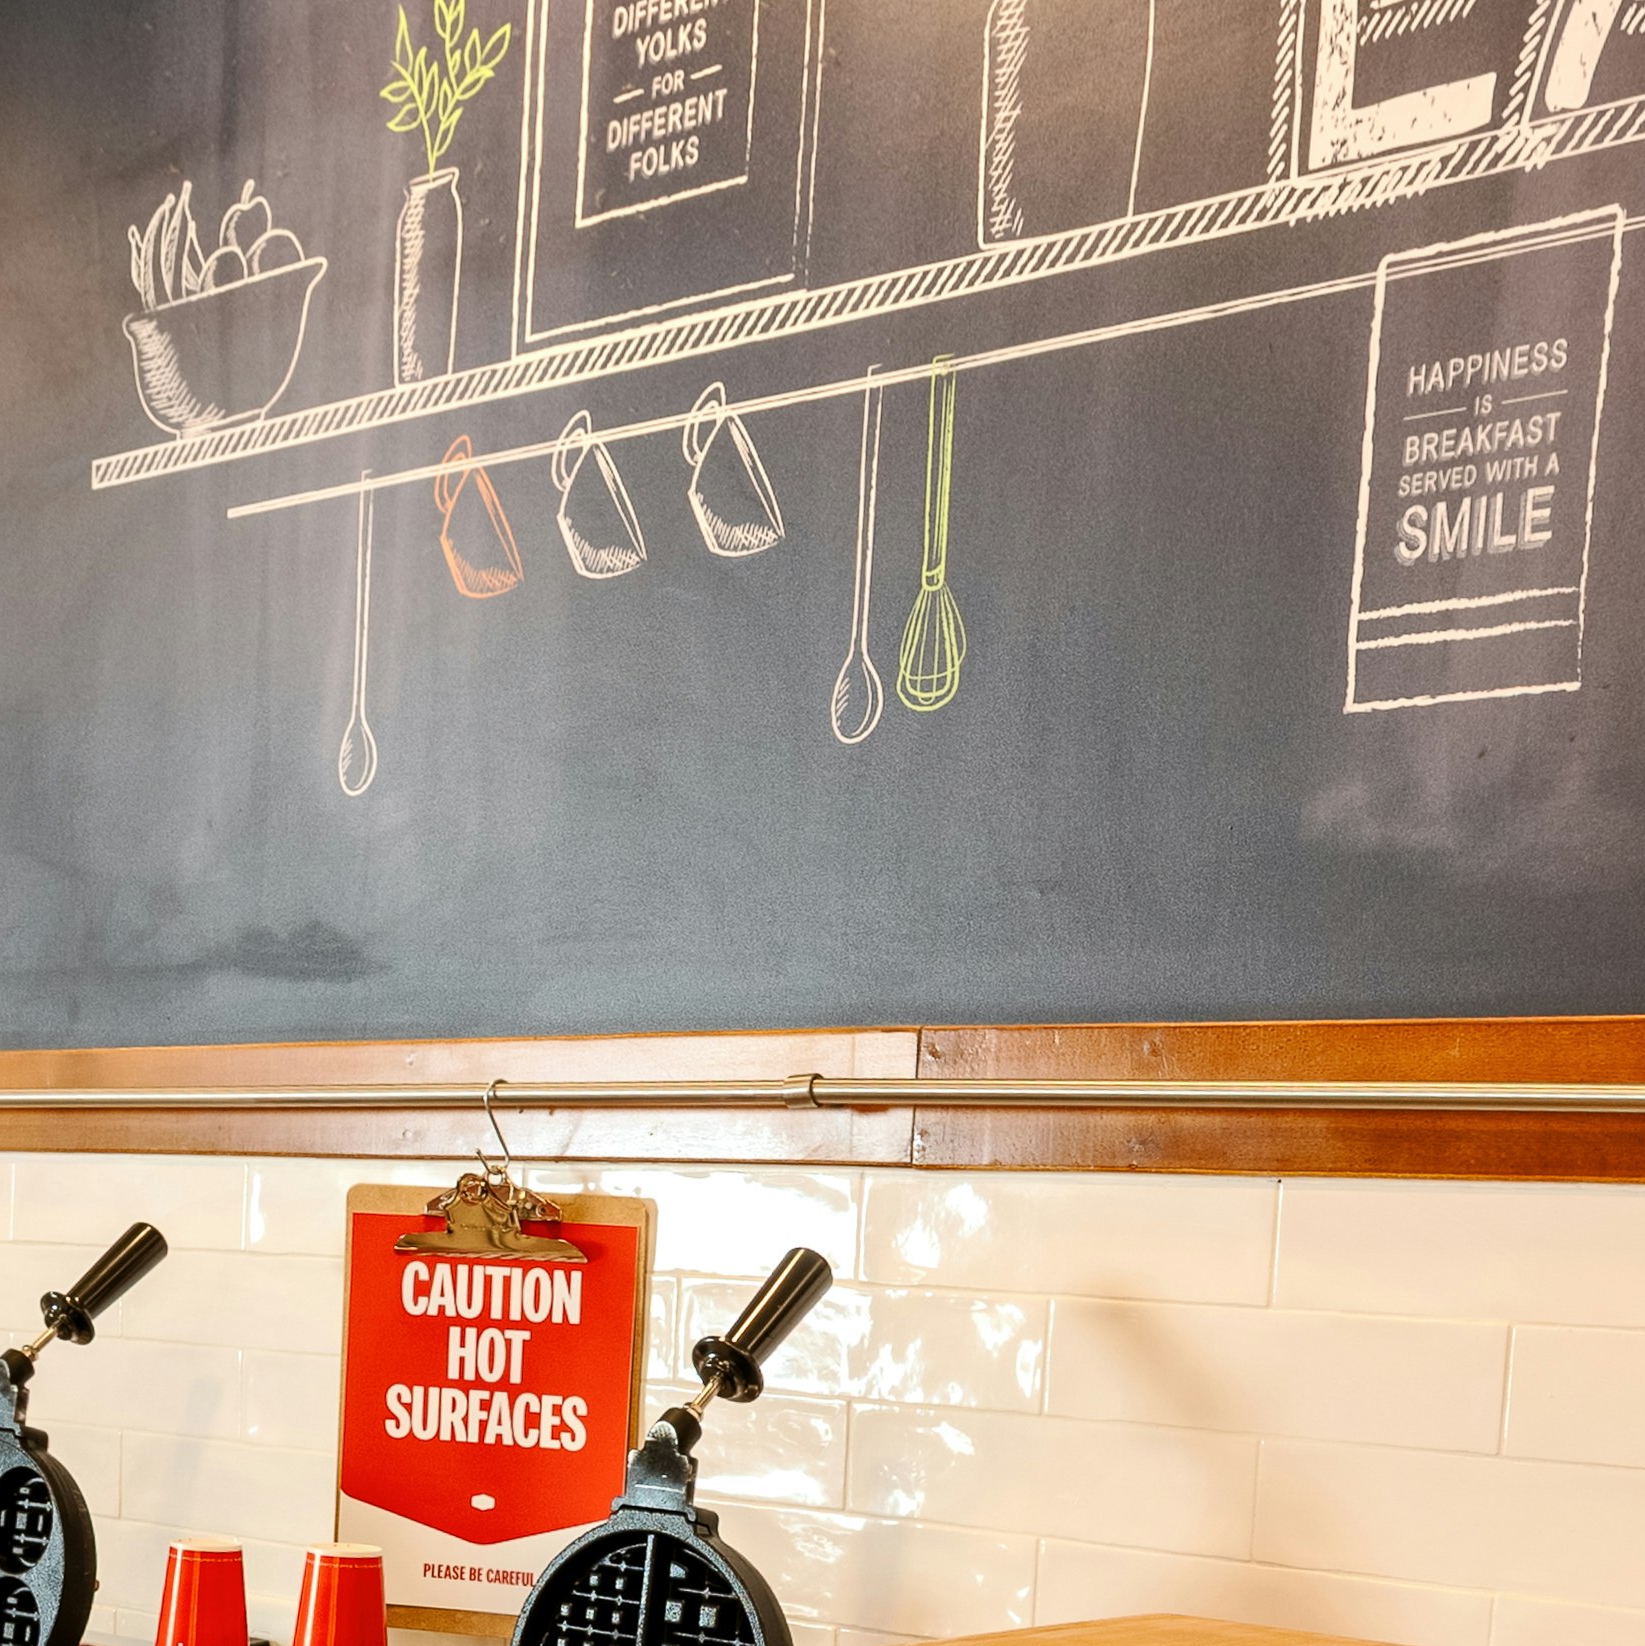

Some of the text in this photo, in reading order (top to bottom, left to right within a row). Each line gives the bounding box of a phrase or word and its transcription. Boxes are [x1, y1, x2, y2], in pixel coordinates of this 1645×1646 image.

[636, 18, 708, 68] YOLKS
[652, 69, 685, 98] FOR
[606, 88, 728, 152] DIFFERENT
[629, 135, 700, 182] FOLKS
[1407, 338, 1568, 397] HAPPINESS
[1474, 394, 1493, 416] IS
[1402, 412, 1562, 466] BREAKFAST
[1398, 452, 1560, 498] SERVED WITH A
[1395, 485, 1555, 564] SMILE
[401, 1260, 583, 1326] CAUTION
[447, 1326, 531, 1384] HOT
[384, 1384, 588, 1452] SURFACES
[423, 1563, 535, 1587] PLEASE BE CAREFUL
